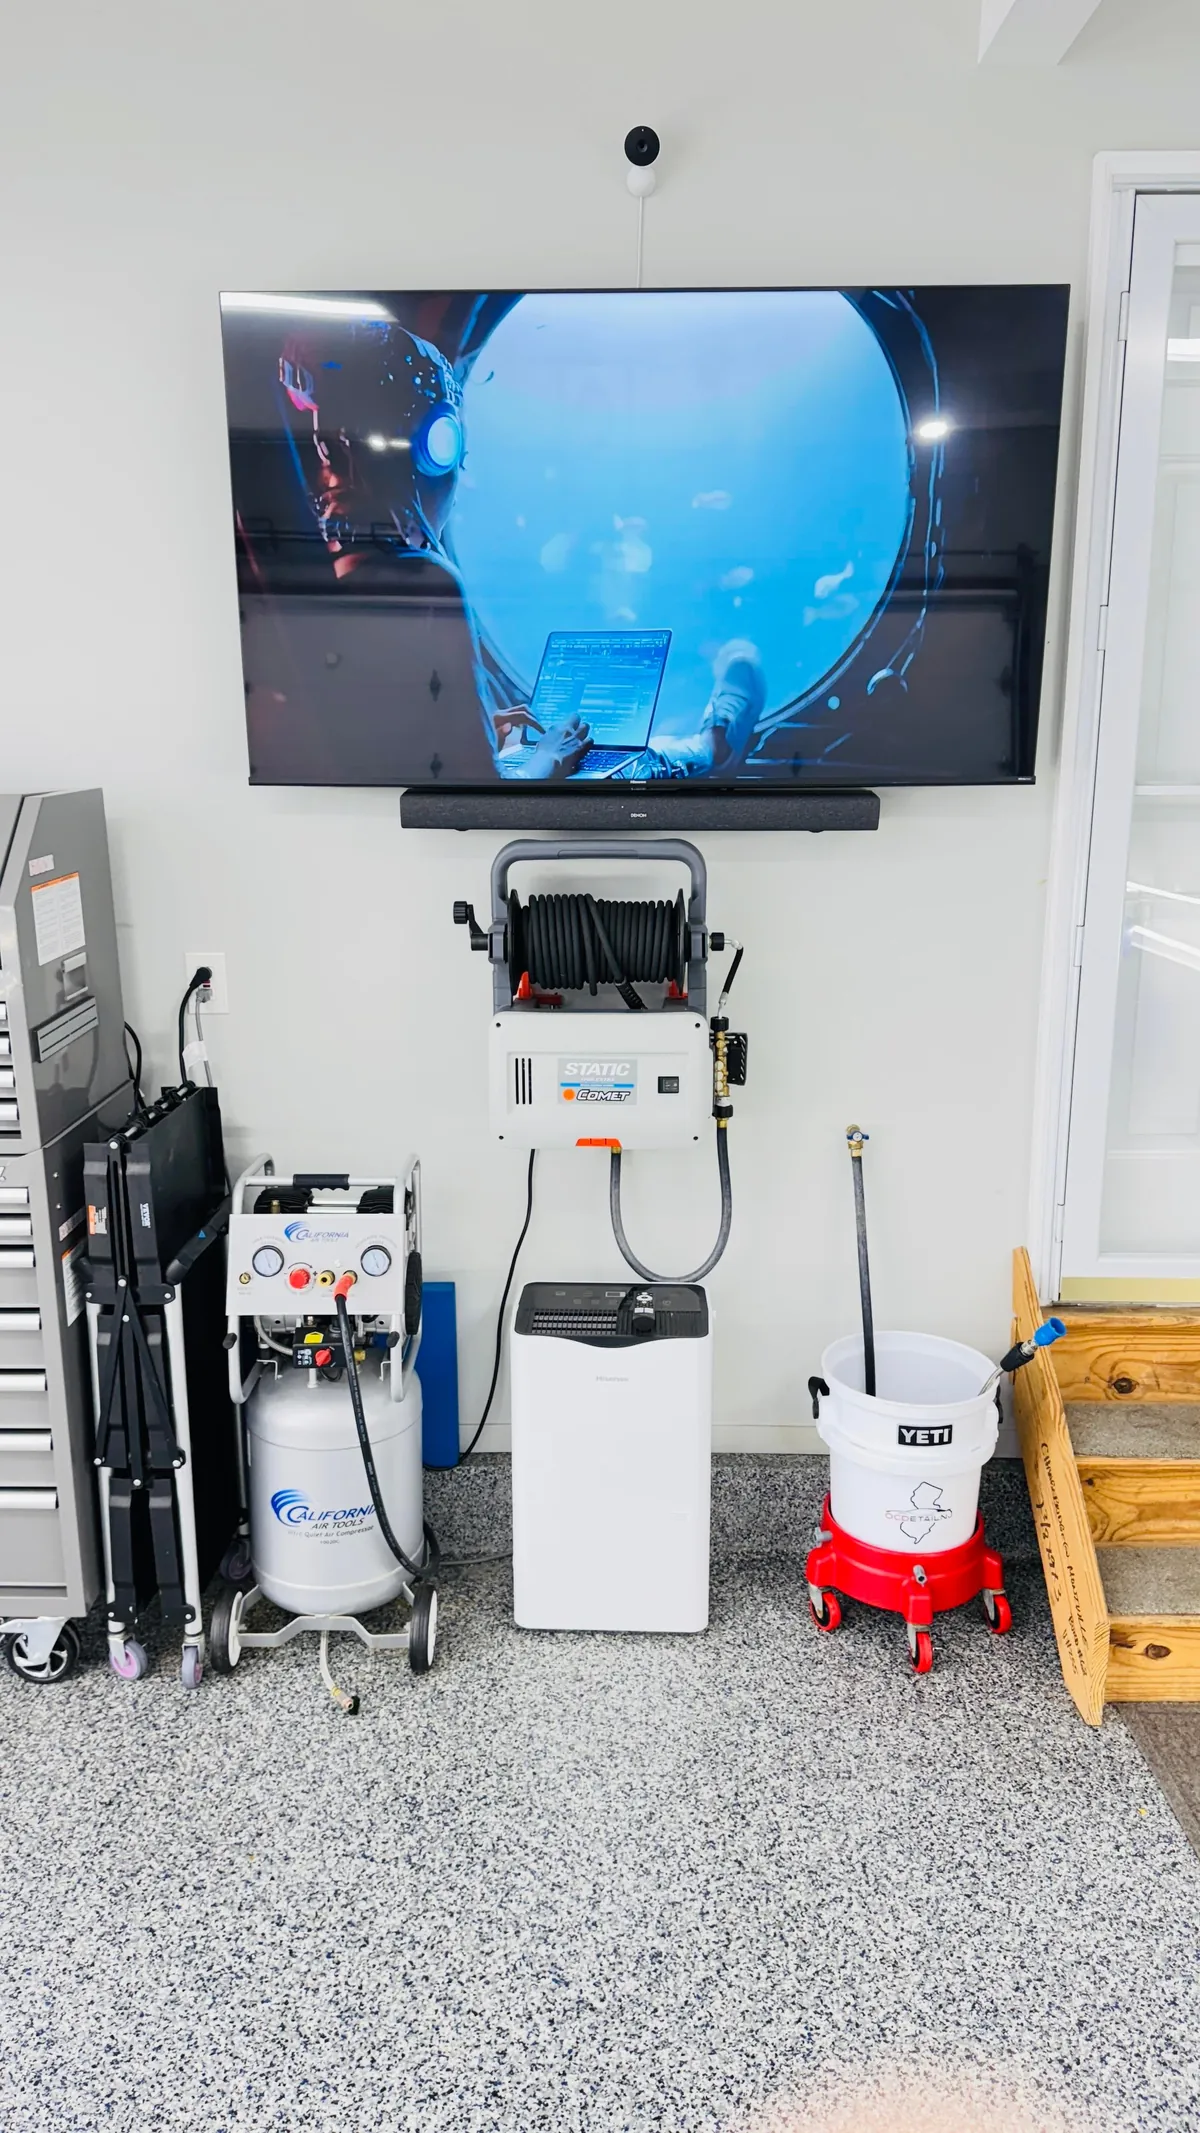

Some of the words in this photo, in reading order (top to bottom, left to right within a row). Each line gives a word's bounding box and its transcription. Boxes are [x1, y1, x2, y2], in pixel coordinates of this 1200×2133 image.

[564, 1062, 630, 1076] STATIC
[576, 1089, 631, 1101] COMET
[296, 1229, 349, 1240] CALIFORNIA
[900, 1428, 950, 1444] YETI
[332, 1517, 364, 1528] TOOLS
[336, 1525, 374, 1537] Compressor
